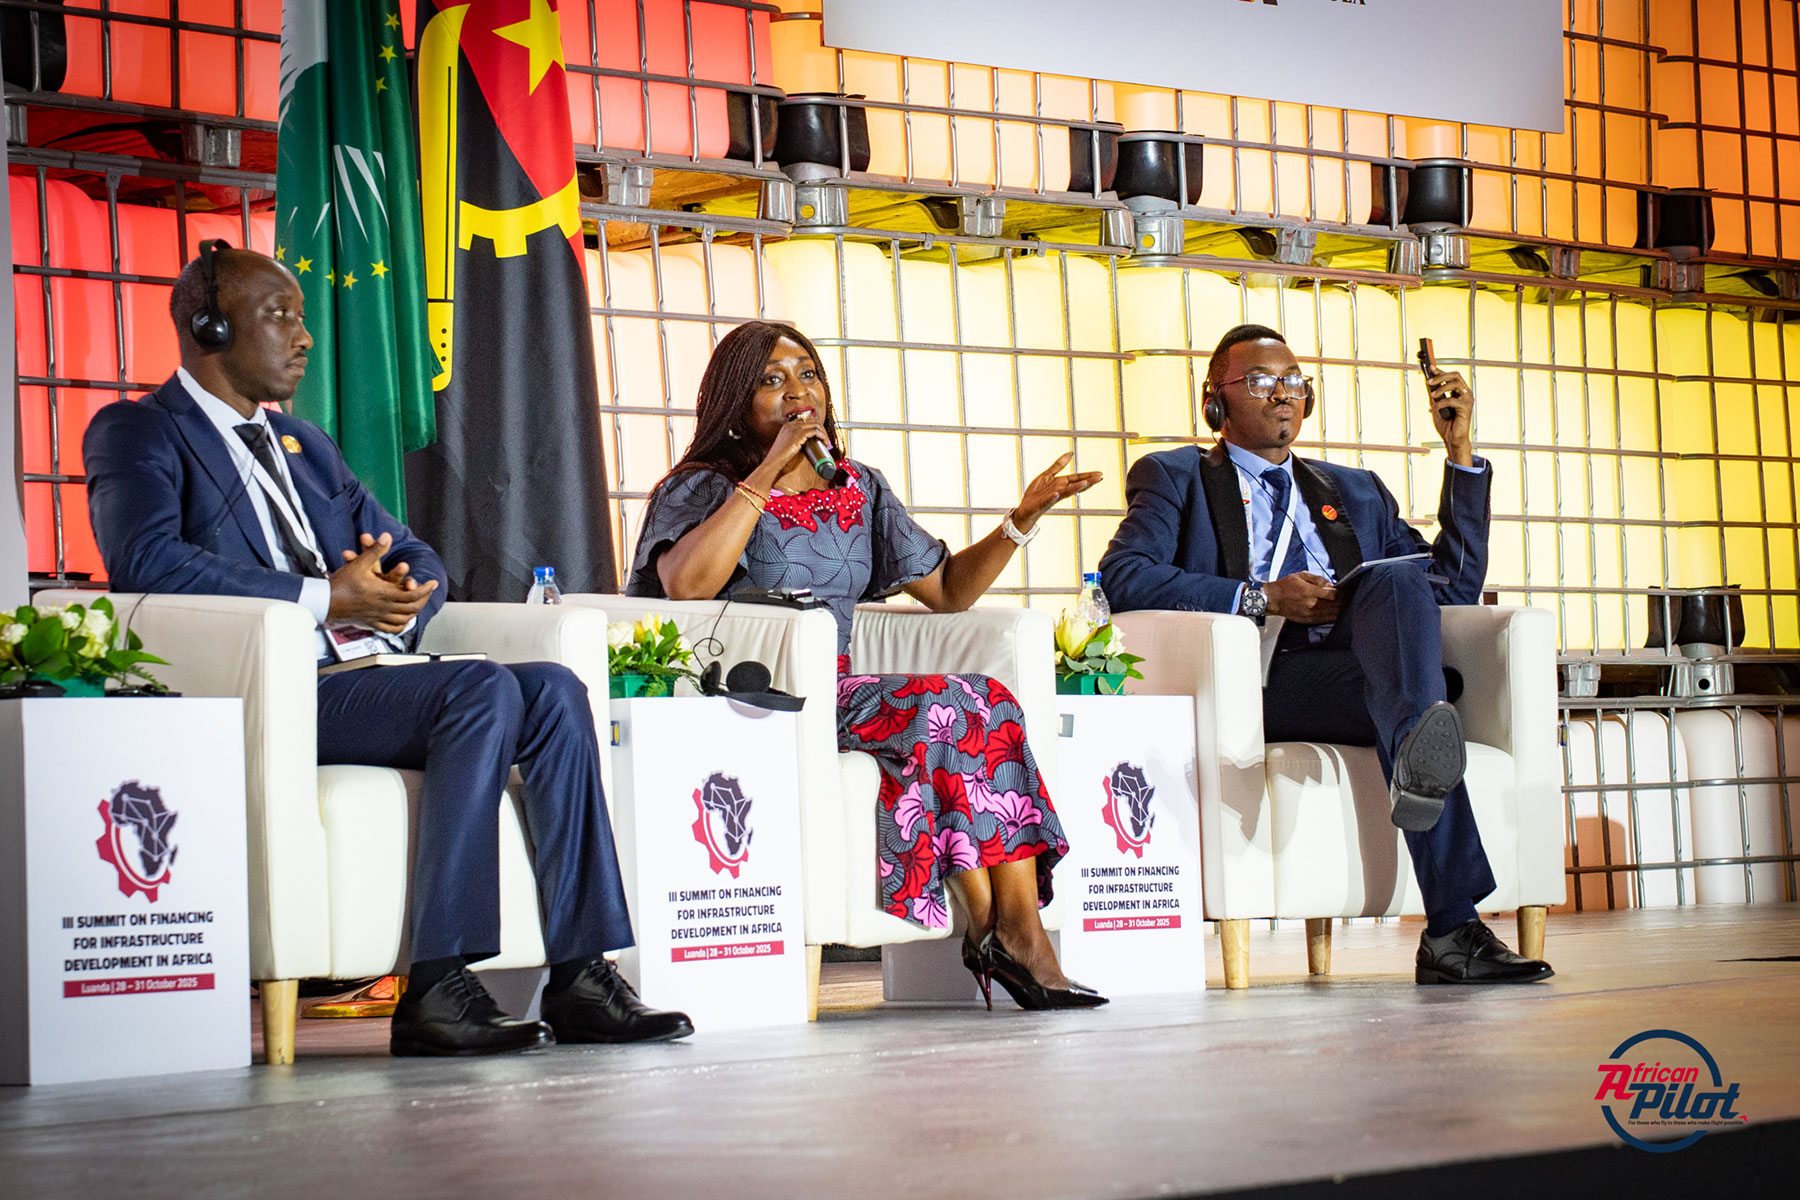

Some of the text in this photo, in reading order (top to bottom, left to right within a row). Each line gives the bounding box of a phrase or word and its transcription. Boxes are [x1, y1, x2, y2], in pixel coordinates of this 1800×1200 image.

[1081, 865, 1179, 878] III SUMMIT ON FINANCING
[668, 885, 782, 902] III SUMMIT ON FINANCING
[1088, 882, 1173, 894] FOR INFRASTRUCTURE
[677, 904, 775, 920] FOR INFRASTRUCTURE
[1083, 899, 1180, 911] DEVELOPMENT IN AFRICA
[62, 911, 213, 929] III SUMMIT ON FINANCING
[671, 922, 782, 940] DEVELOPMENT IN AFRICA
[73, 932, 204, 950] FOR INFRASTRUCTURE
[684, 948, 706, 959] Luanda
[710, 947, 718, 957] 28
[723, 946, 732, 956] 31
[732, 944, 755, 955] October
[756, 943, 771, 953] 2025
[65, 952, 213, 972] DEVELOPMENT IN AFRICA
[81, 982, 110, 994] Luanda
[115, 981, 127, 991] 28
[134, 980, 145, 991] 31
[146, 978, 176, 990] October
[177, 977, 198, 988] 2025
